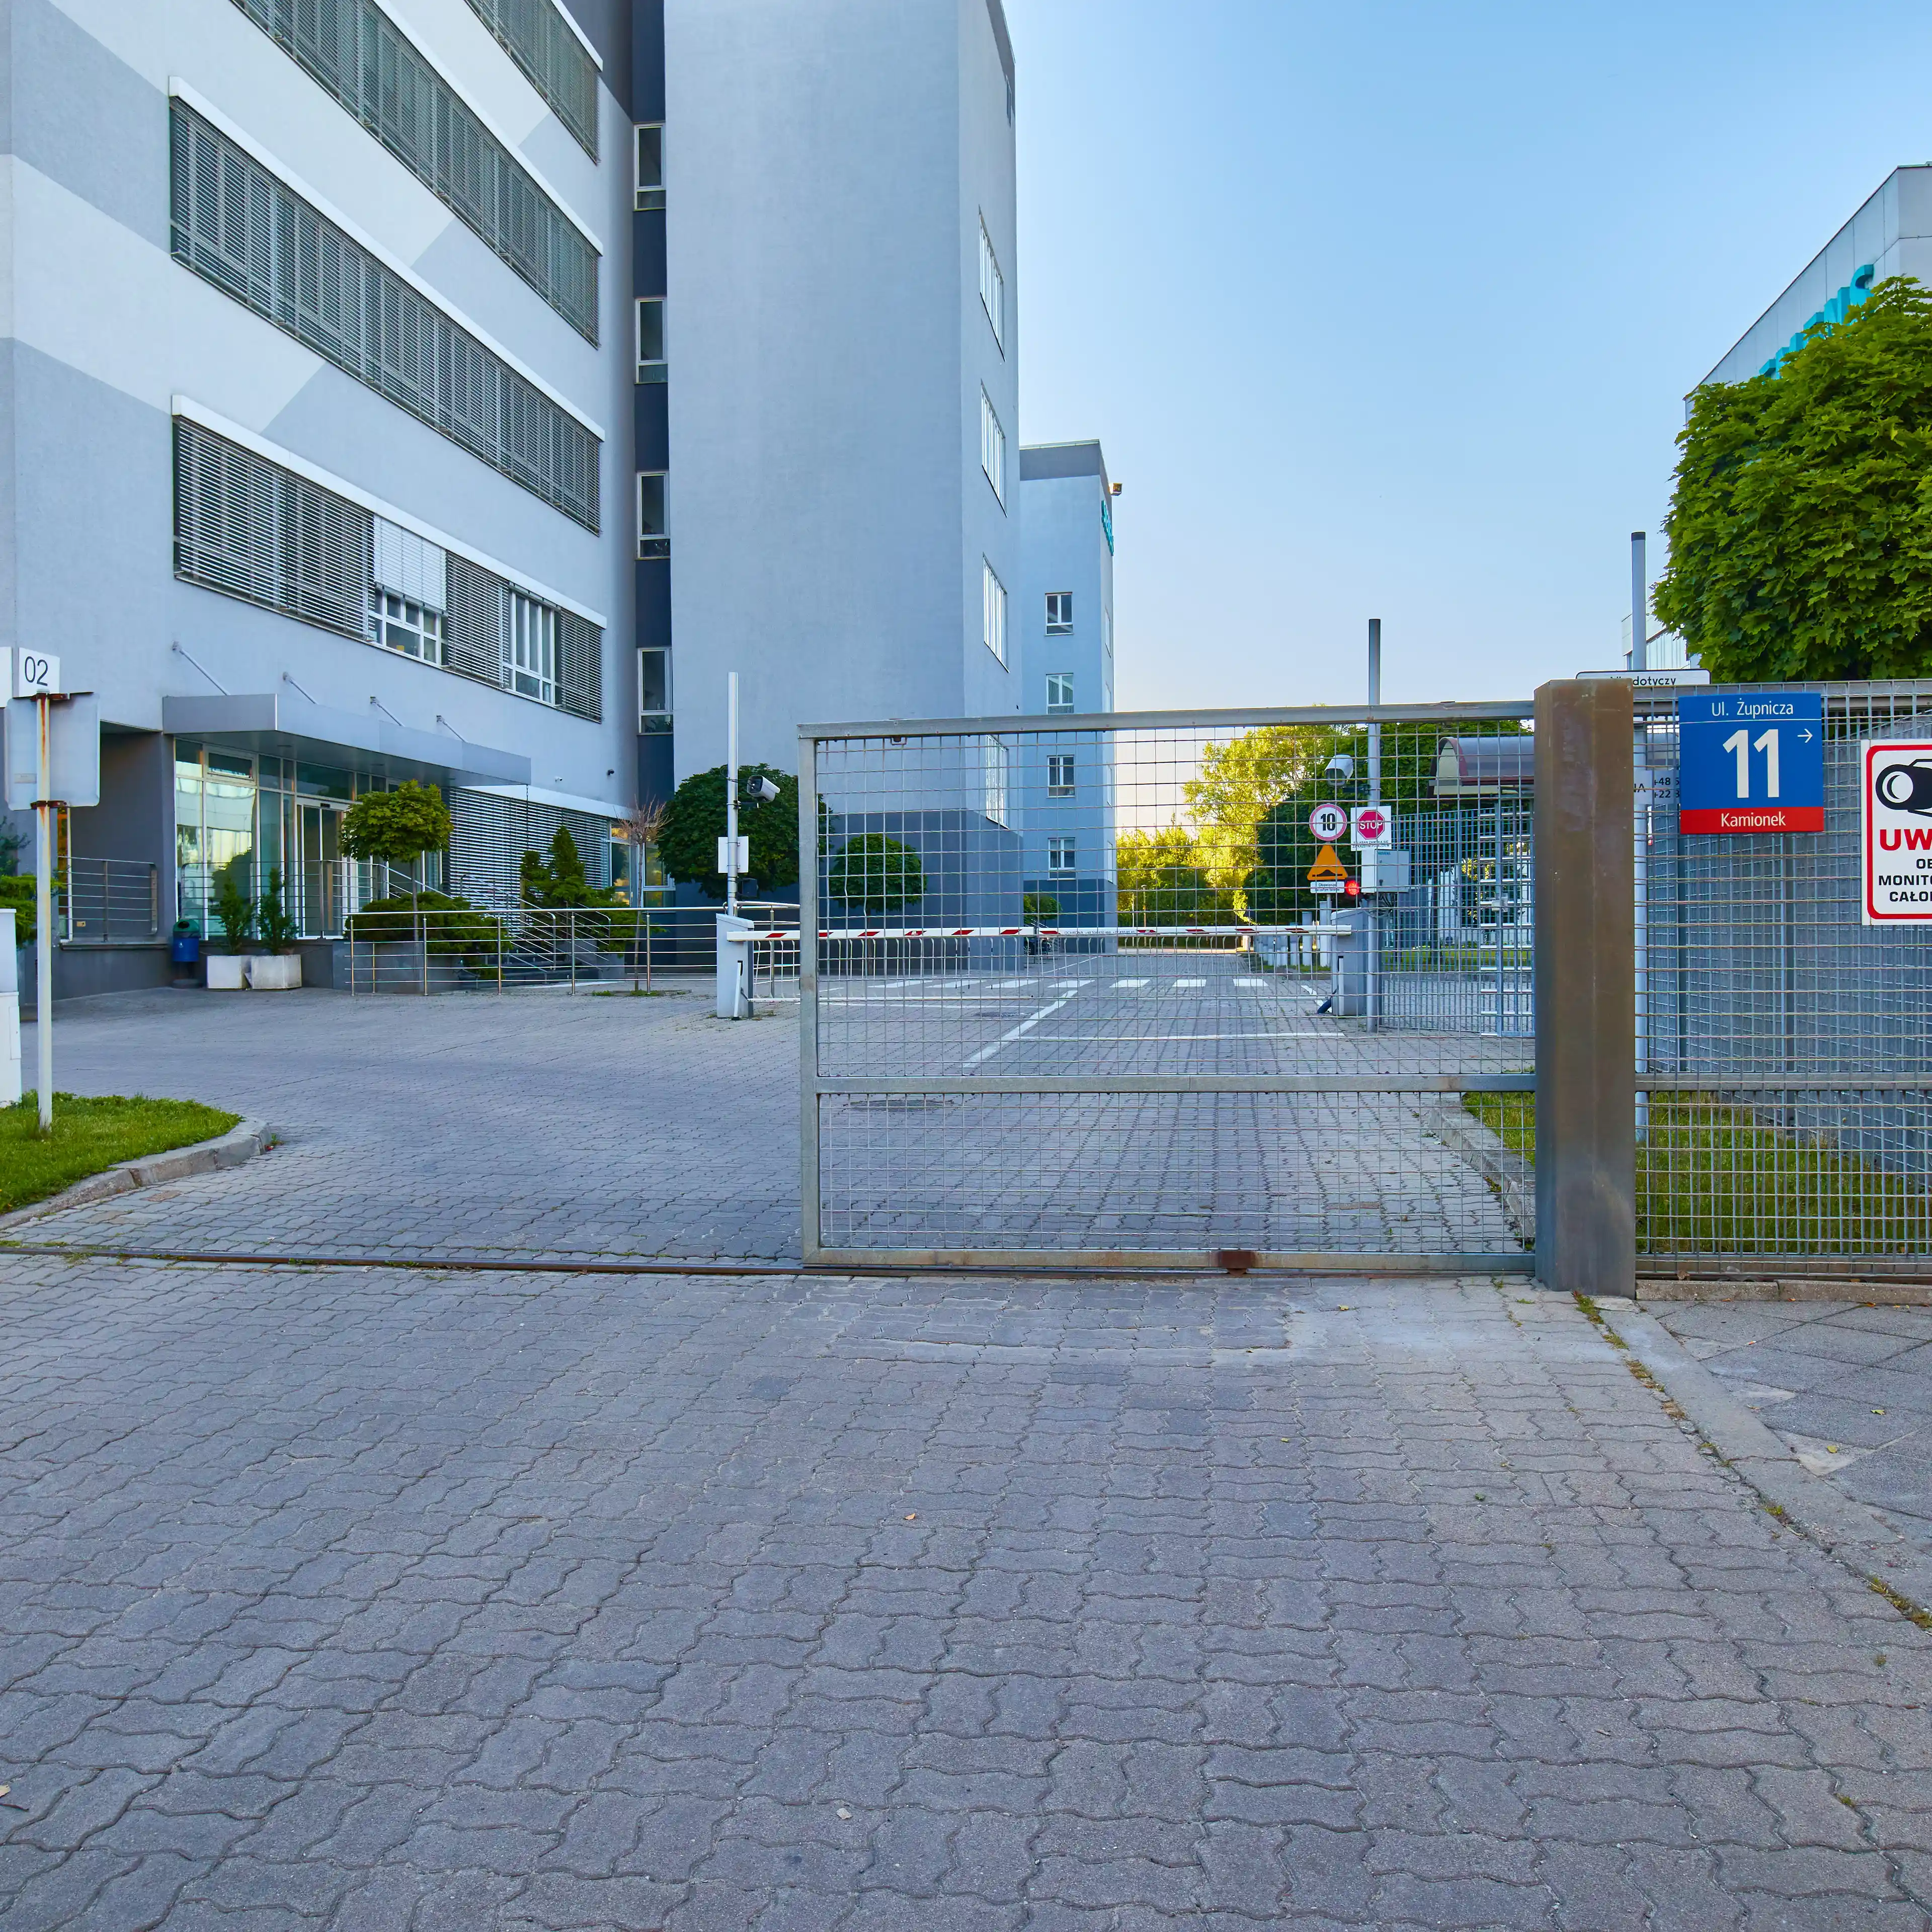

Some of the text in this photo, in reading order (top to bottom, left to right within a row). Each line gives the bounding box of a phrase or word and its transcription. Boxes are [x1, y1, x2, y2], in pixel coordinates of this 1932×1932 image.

[25, 656, 48, 686] 02
[1633, 676, 1676, 685] dotyczy
[1712, 698, 1794, 719] Ul. Żupnicza
[1723, 729, 1780, 798] 11
[1321, 813, 1335, 831] 10
[1360, 820, 1383, 829] STOP
[1721, 811, 1786, 827] Kamionek
[1879, 875, 1932, 886] MONIT
[1889, 891, 1932, 902] CAŁO
